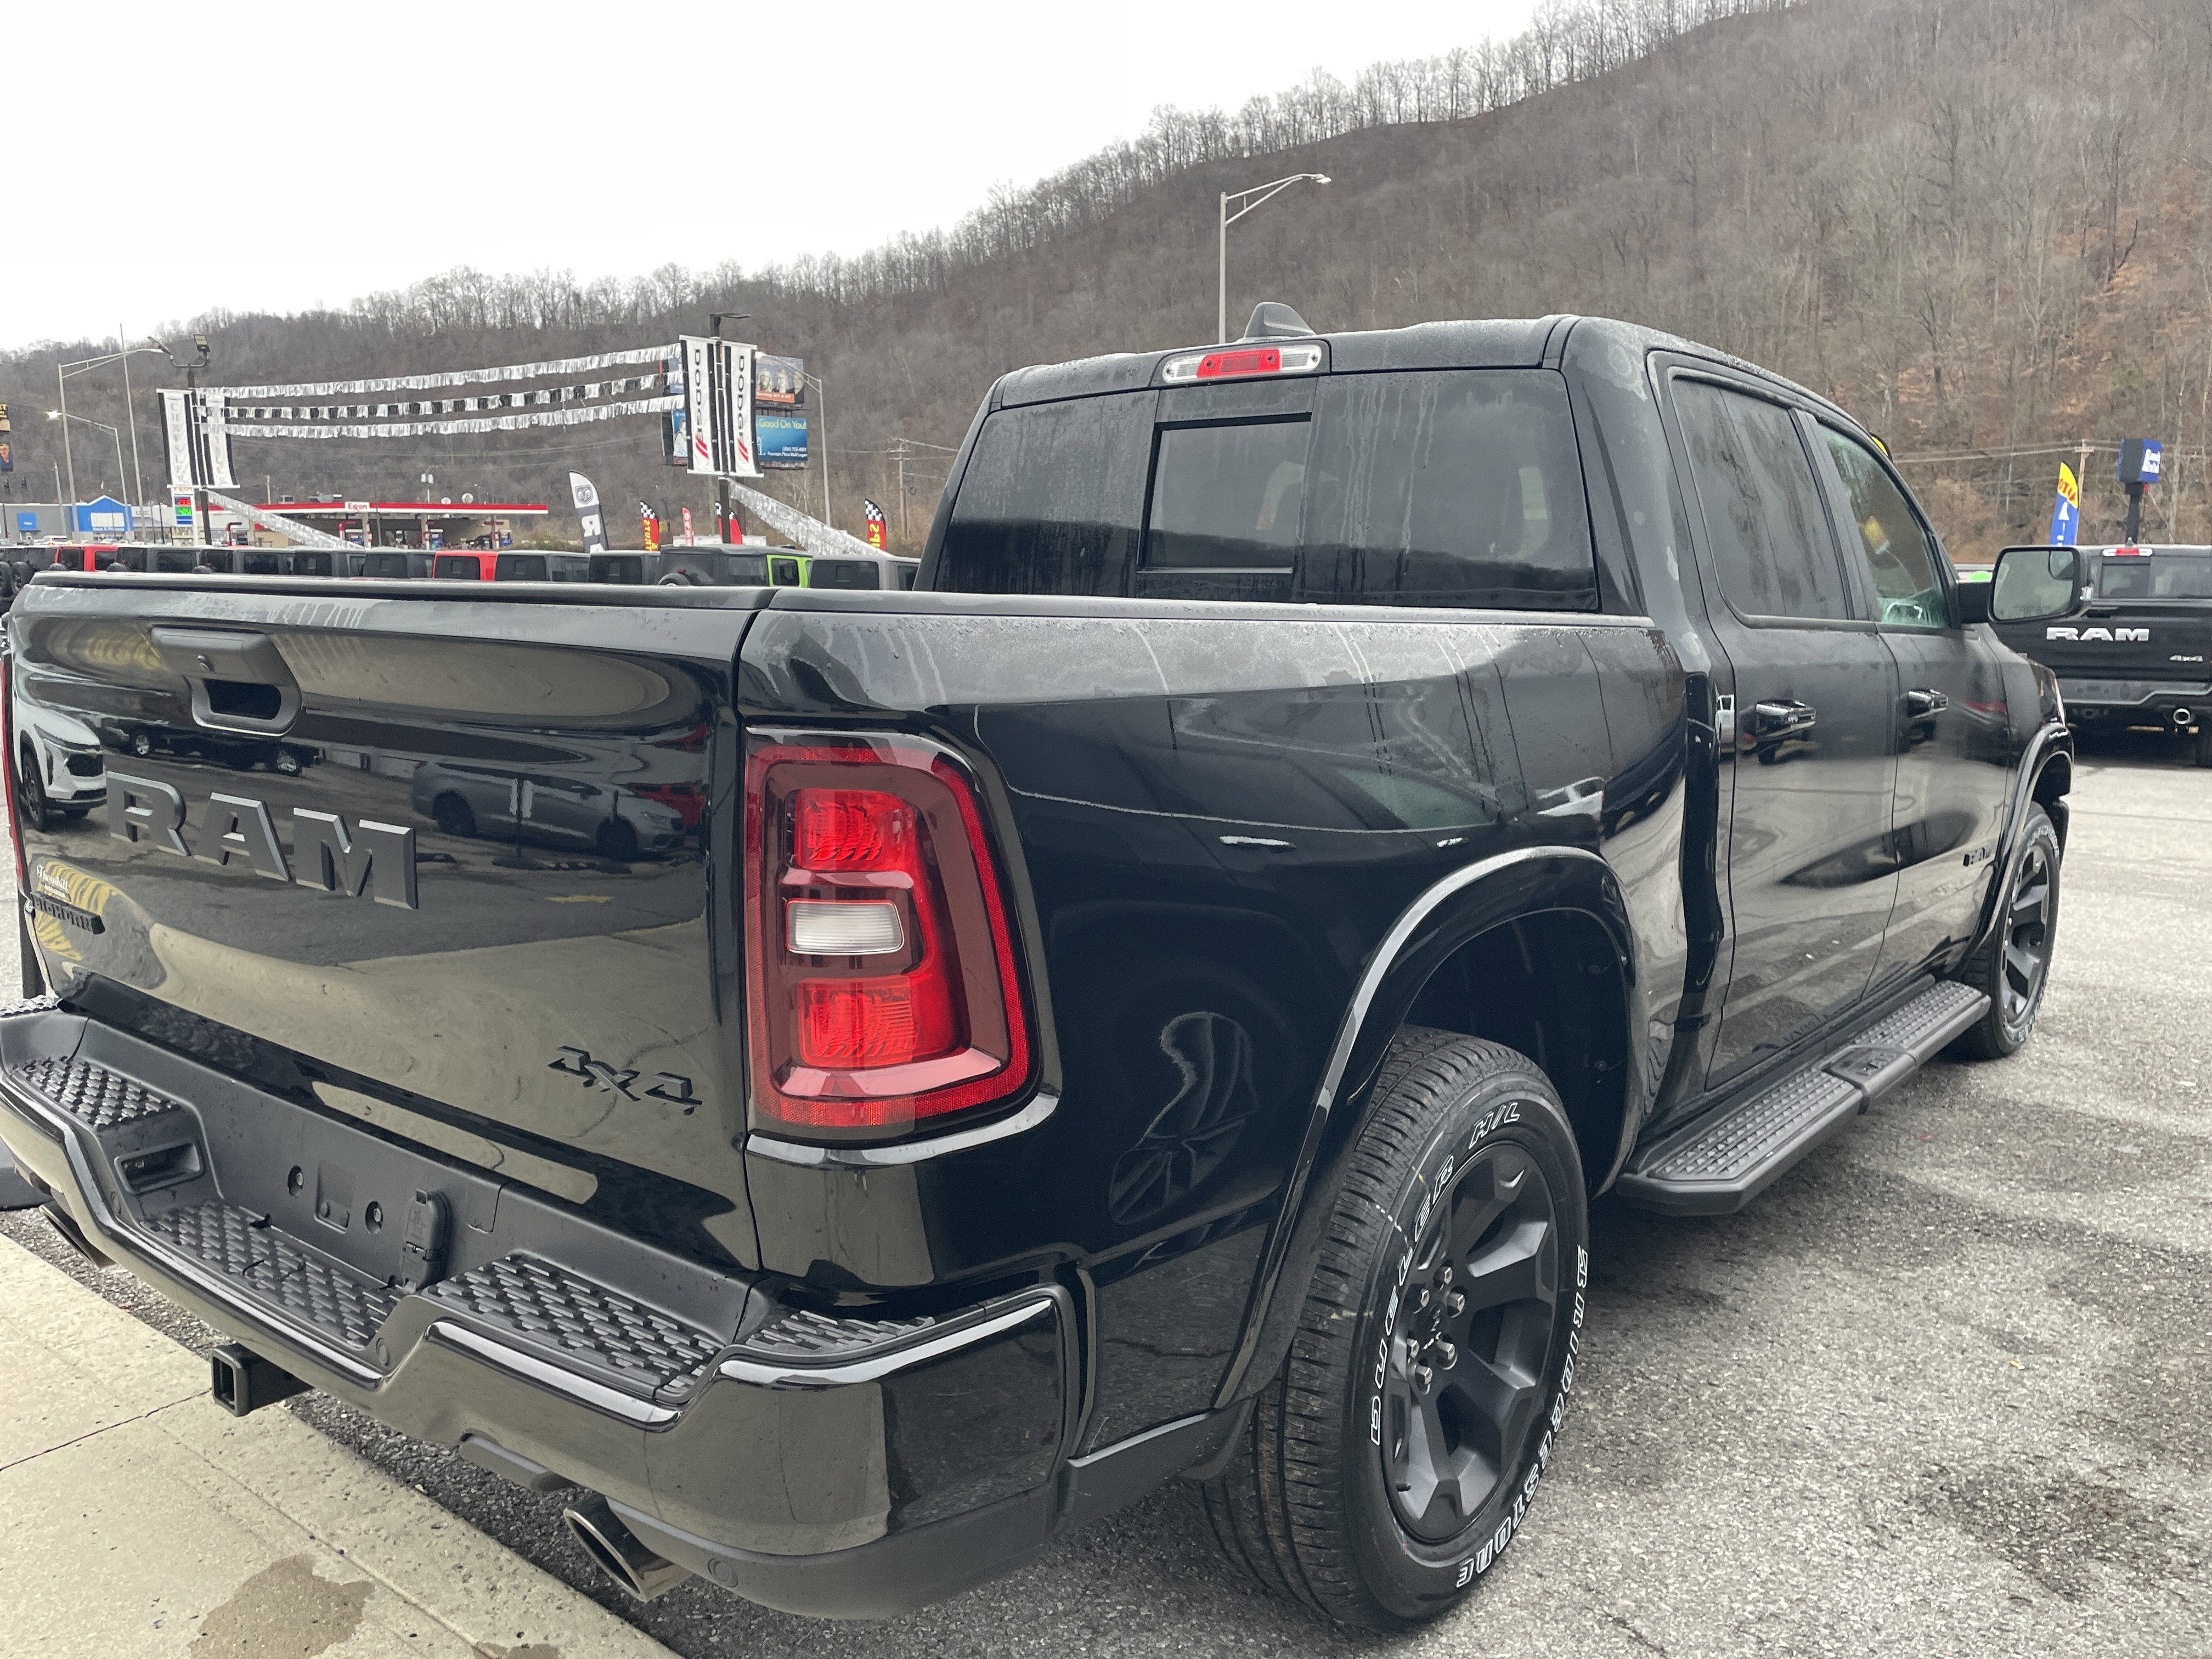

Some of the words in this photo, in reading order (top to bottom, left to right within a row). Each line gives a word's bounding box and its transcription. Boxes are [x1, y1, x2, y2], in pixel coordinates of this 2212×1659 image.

[759, 418, 779, 428] Good
[780, 419, 791, 429] On
[792, 420, 807, 430] You!
[347, 503, 368, 512] Exxon
[2046, 627, 2149, 641] RAM
[106, 771, 419, 910] RAM
[1469, 1102, 1520, 1150] H/L
[1455, 1244, 1589, 1589] BRIDGESTONE
